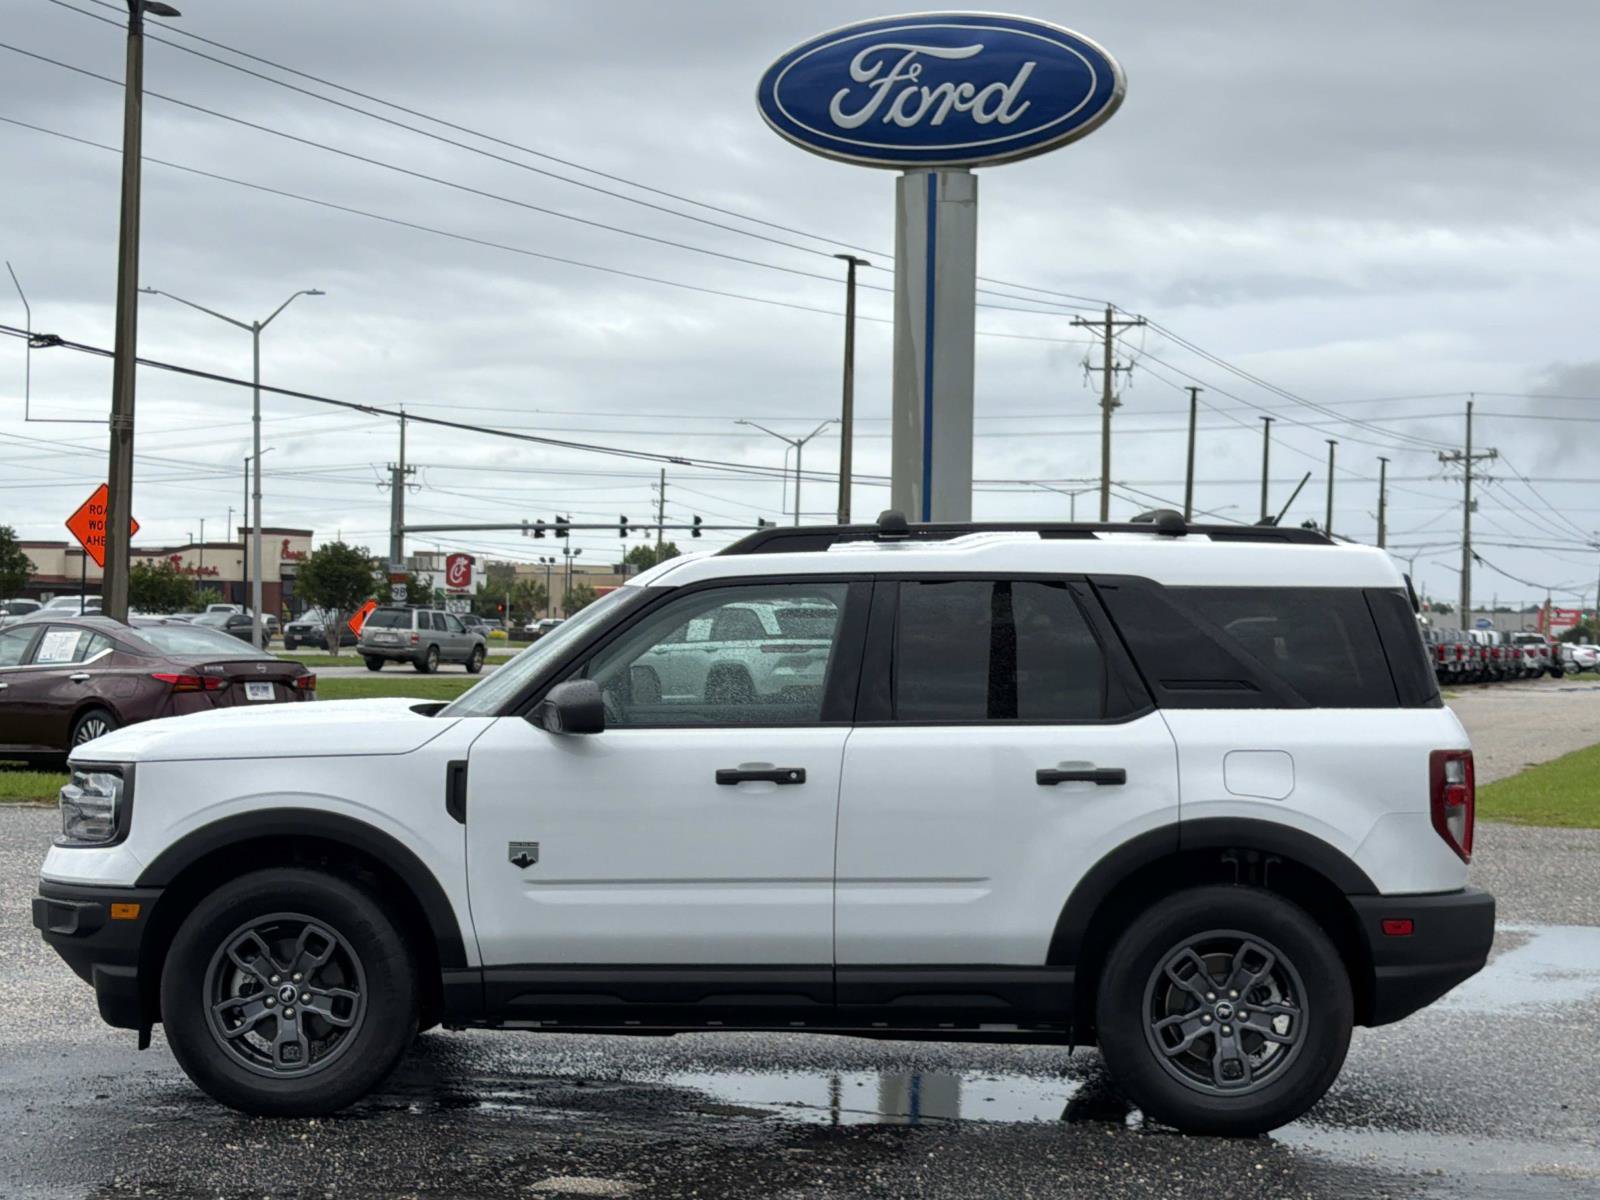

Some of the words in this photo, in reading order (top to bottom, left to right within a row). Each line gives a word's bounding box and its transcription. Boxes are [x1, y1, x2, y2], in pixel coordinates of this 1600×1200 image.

[829, 43, 1037, 129] Ford
[89, 504, 107, 515] RO
[88, 520, 106, 531] WO
[85, 535, 106, 546] AHE
[394, 587, 407, 598] 98
